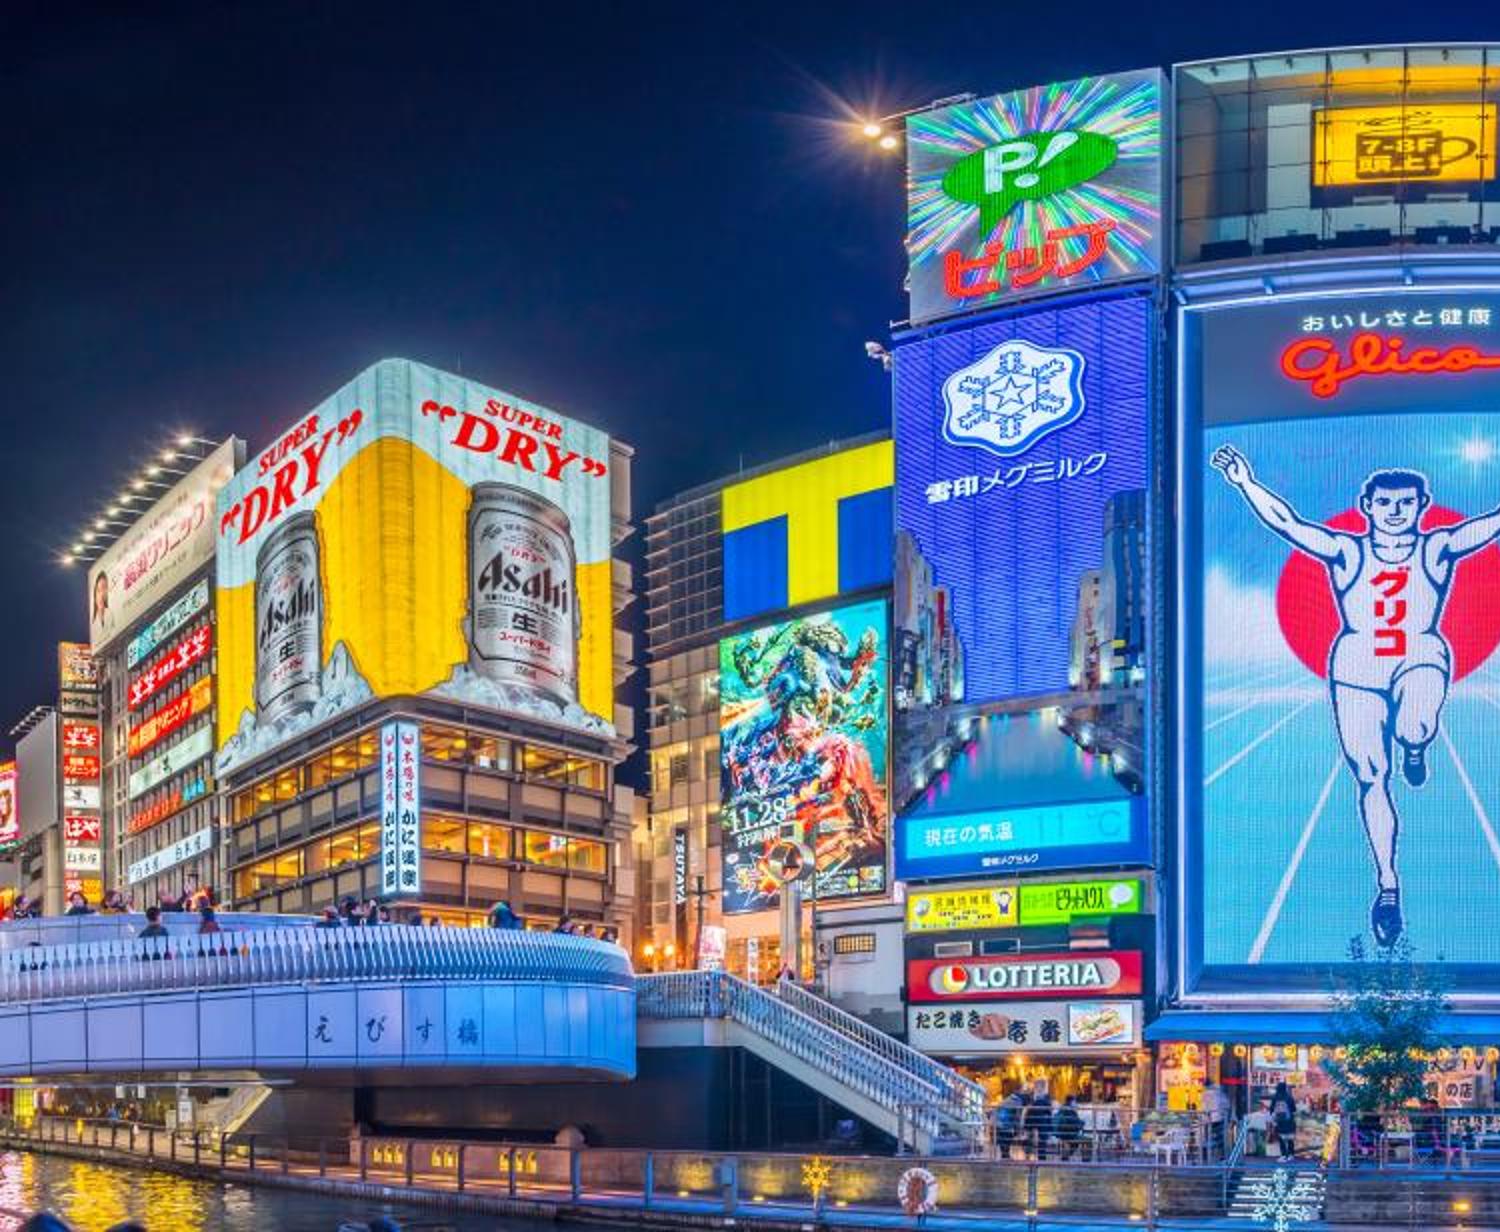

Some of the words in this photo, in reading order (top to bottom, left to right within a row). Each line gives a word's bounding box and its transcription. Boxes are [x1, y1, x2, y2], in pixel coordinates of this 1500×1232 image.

[1303, 309, 1492, 332] おいしさと健康
[483, 399, 563, 431] SUPER
[258, 415, 320, 478] SUPER
[925, 452, 1109, 506] 雪印メグミルク
[478, 550, 568, 616] Asahi
[259, 577, 316, 648] Asahi
[511, 611, 539, 635] 生
[1370, 566, 1411, 658] グリコ
[279, 640, 295, 662] 生
[924, 819, 1014, 848] 現在の気温
[675, 834, 685, 904] TSUTAYA
[973, 962, 1102, 989] LOTTERIA
[915, 1009, 981, 1030] たこ焼き
